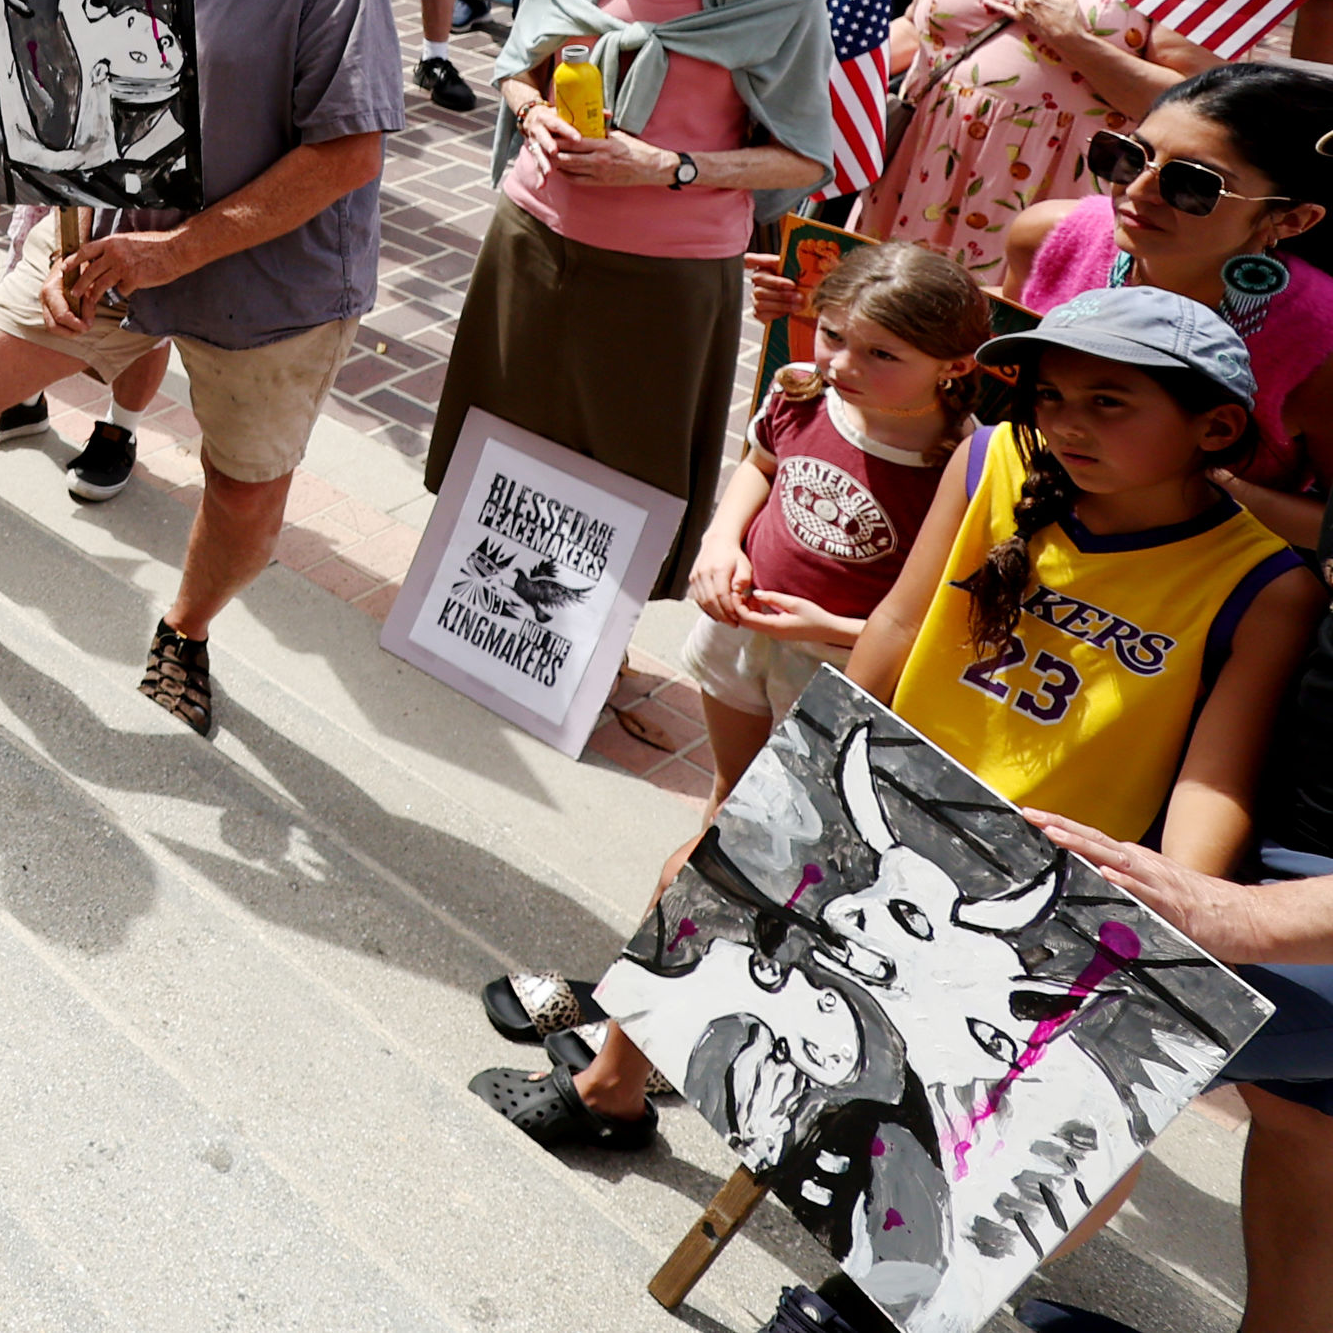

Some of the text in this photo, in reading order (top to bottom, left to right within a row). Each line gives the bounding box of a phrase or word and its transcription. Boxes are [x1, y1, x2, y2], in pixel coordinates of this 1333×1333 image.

[488, 472, 617, 544] BLESSED ARE
[785, 459, 888, 534] SKATER GIRL
[478, 500, 608, 582] PEACEMAKERS
[584, 533, 611, 556] THE
[797, 525, 823, 550] THE
[824, 540, 879, 559] DREAM
[437, 596, 564, 688] KINGMAKERS
[520, 619, 572, 658] NOT THE
[958, 634, 1084, 727] 23
